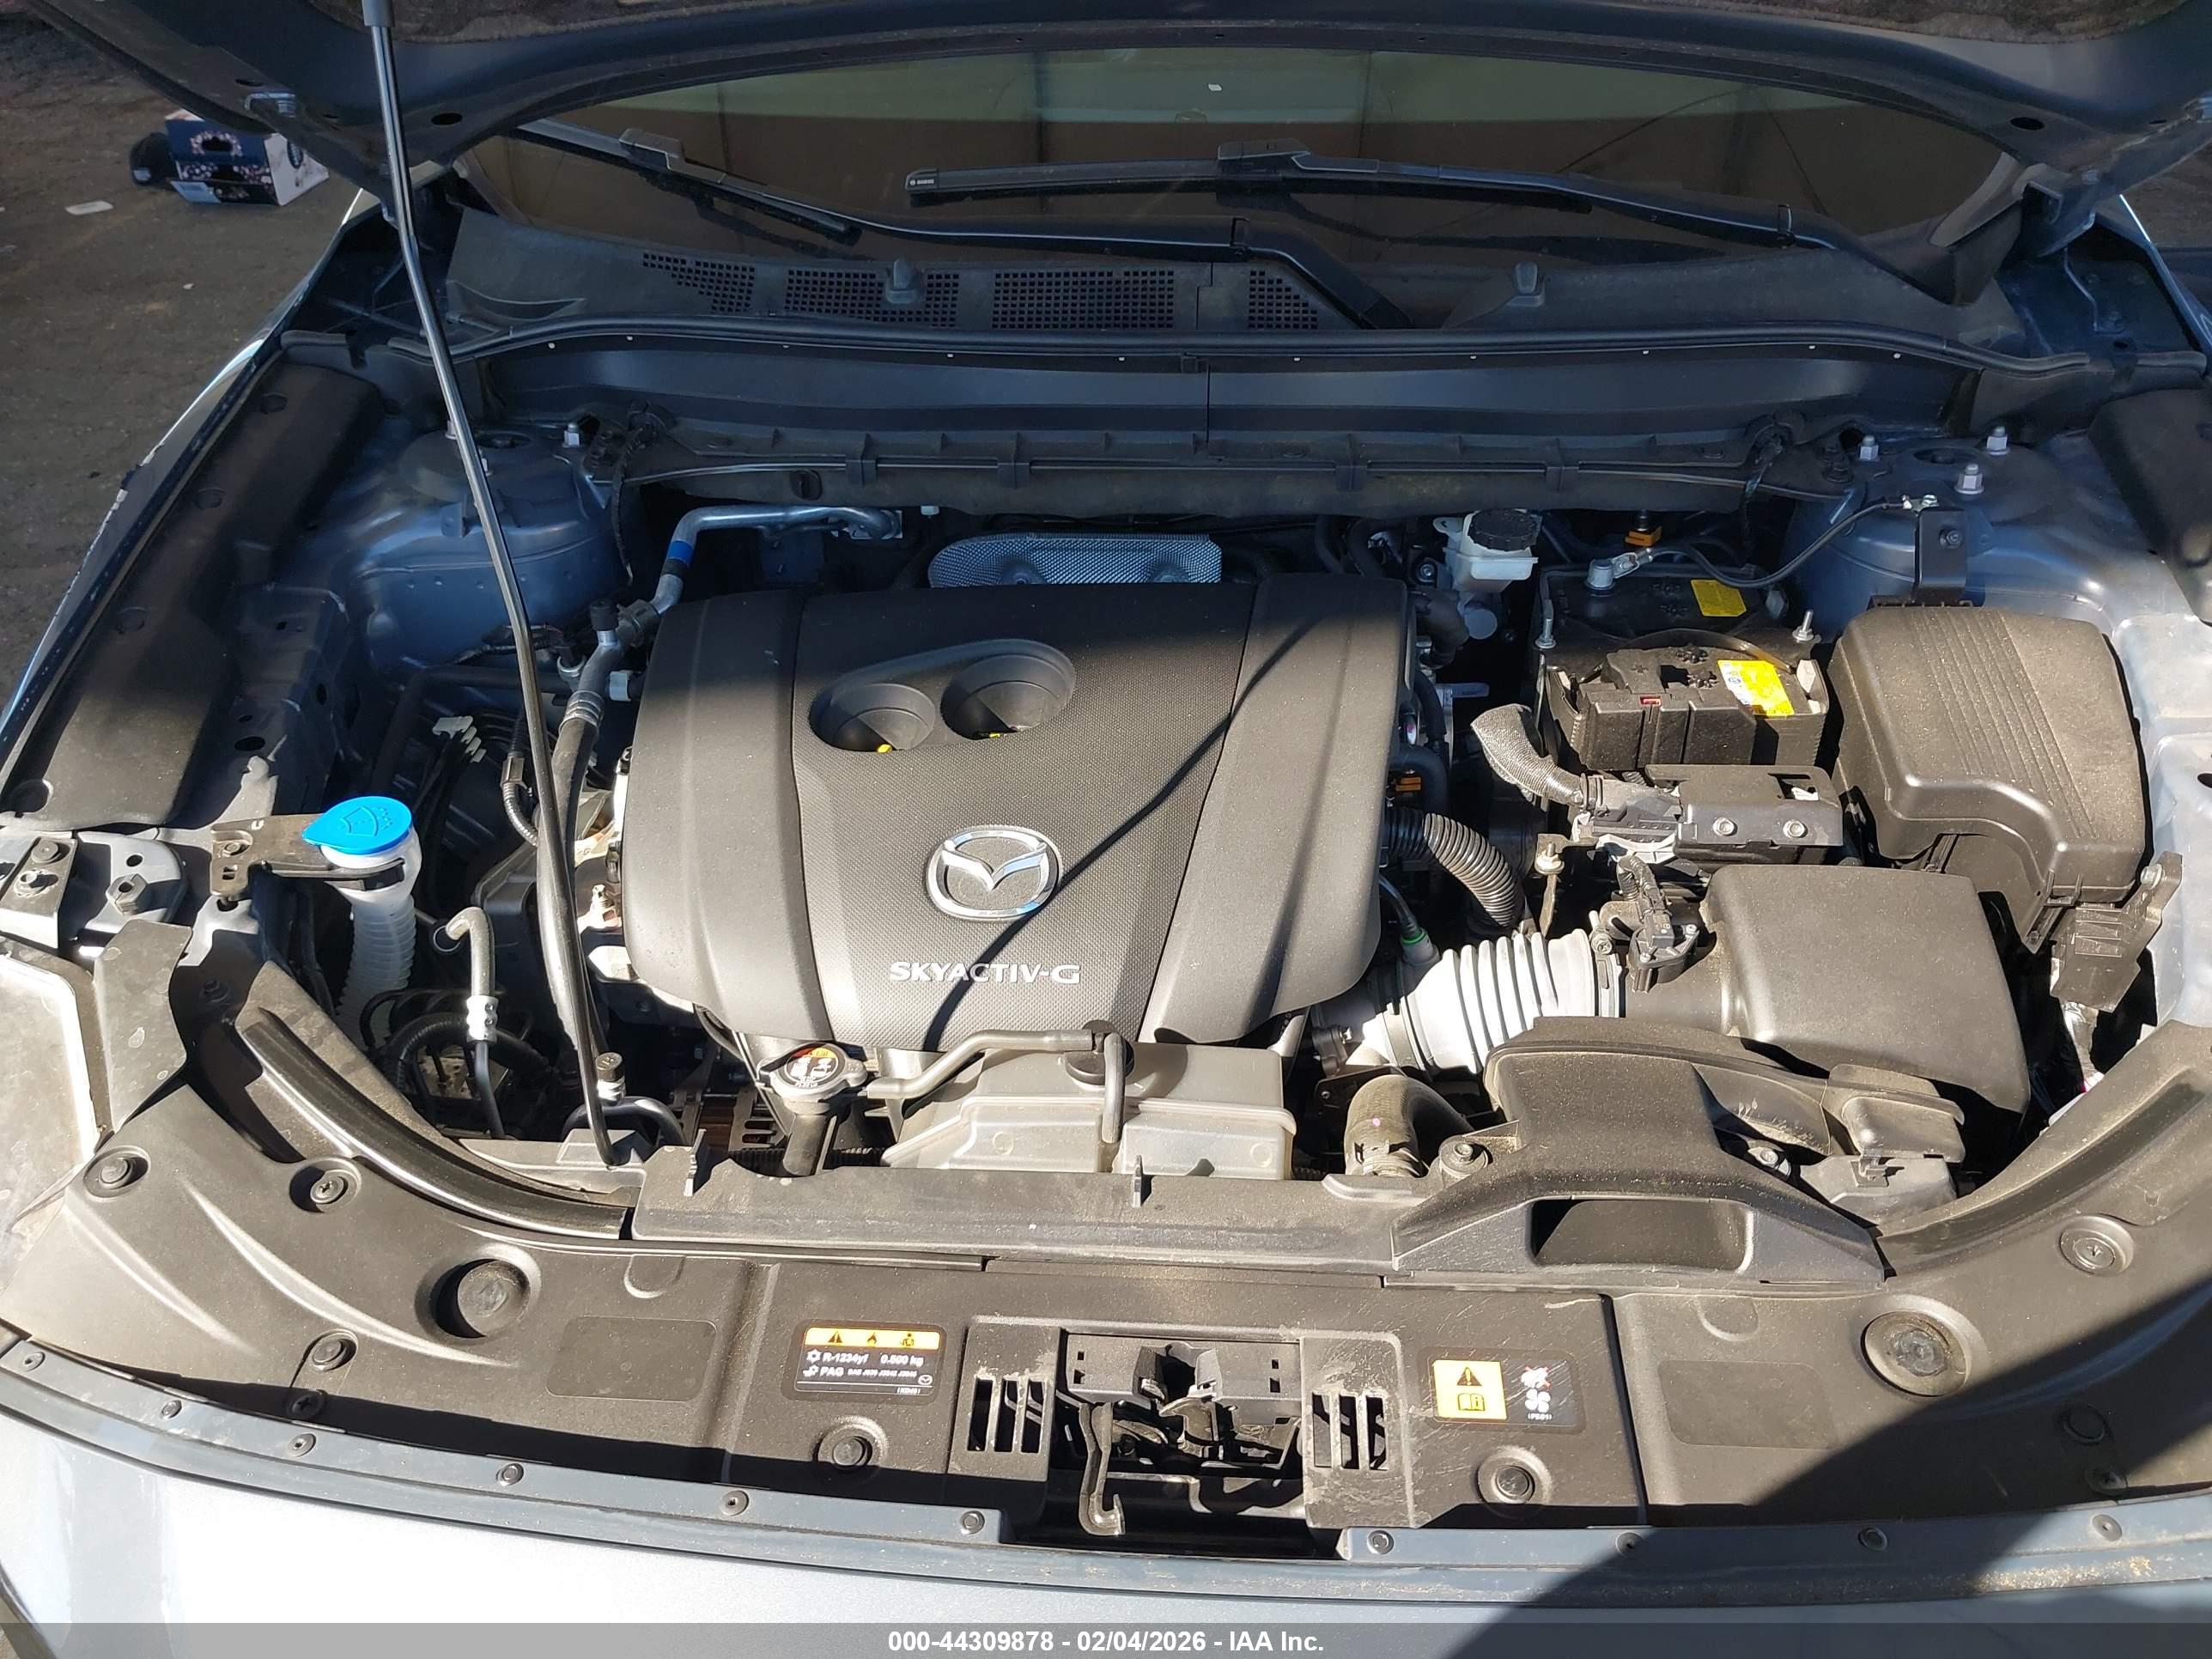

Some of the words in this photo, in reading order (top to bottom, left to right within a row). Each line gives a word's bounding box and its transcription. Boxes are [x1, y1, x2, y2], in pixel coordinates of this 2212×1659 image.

[890, 961, 1081, 984] SKYACTIV-G
[822, 1352, 869, 1365] R-1234yf
[909, 1355, 924, 1367] kg
[820, 1366, 844, 1376] PAG
